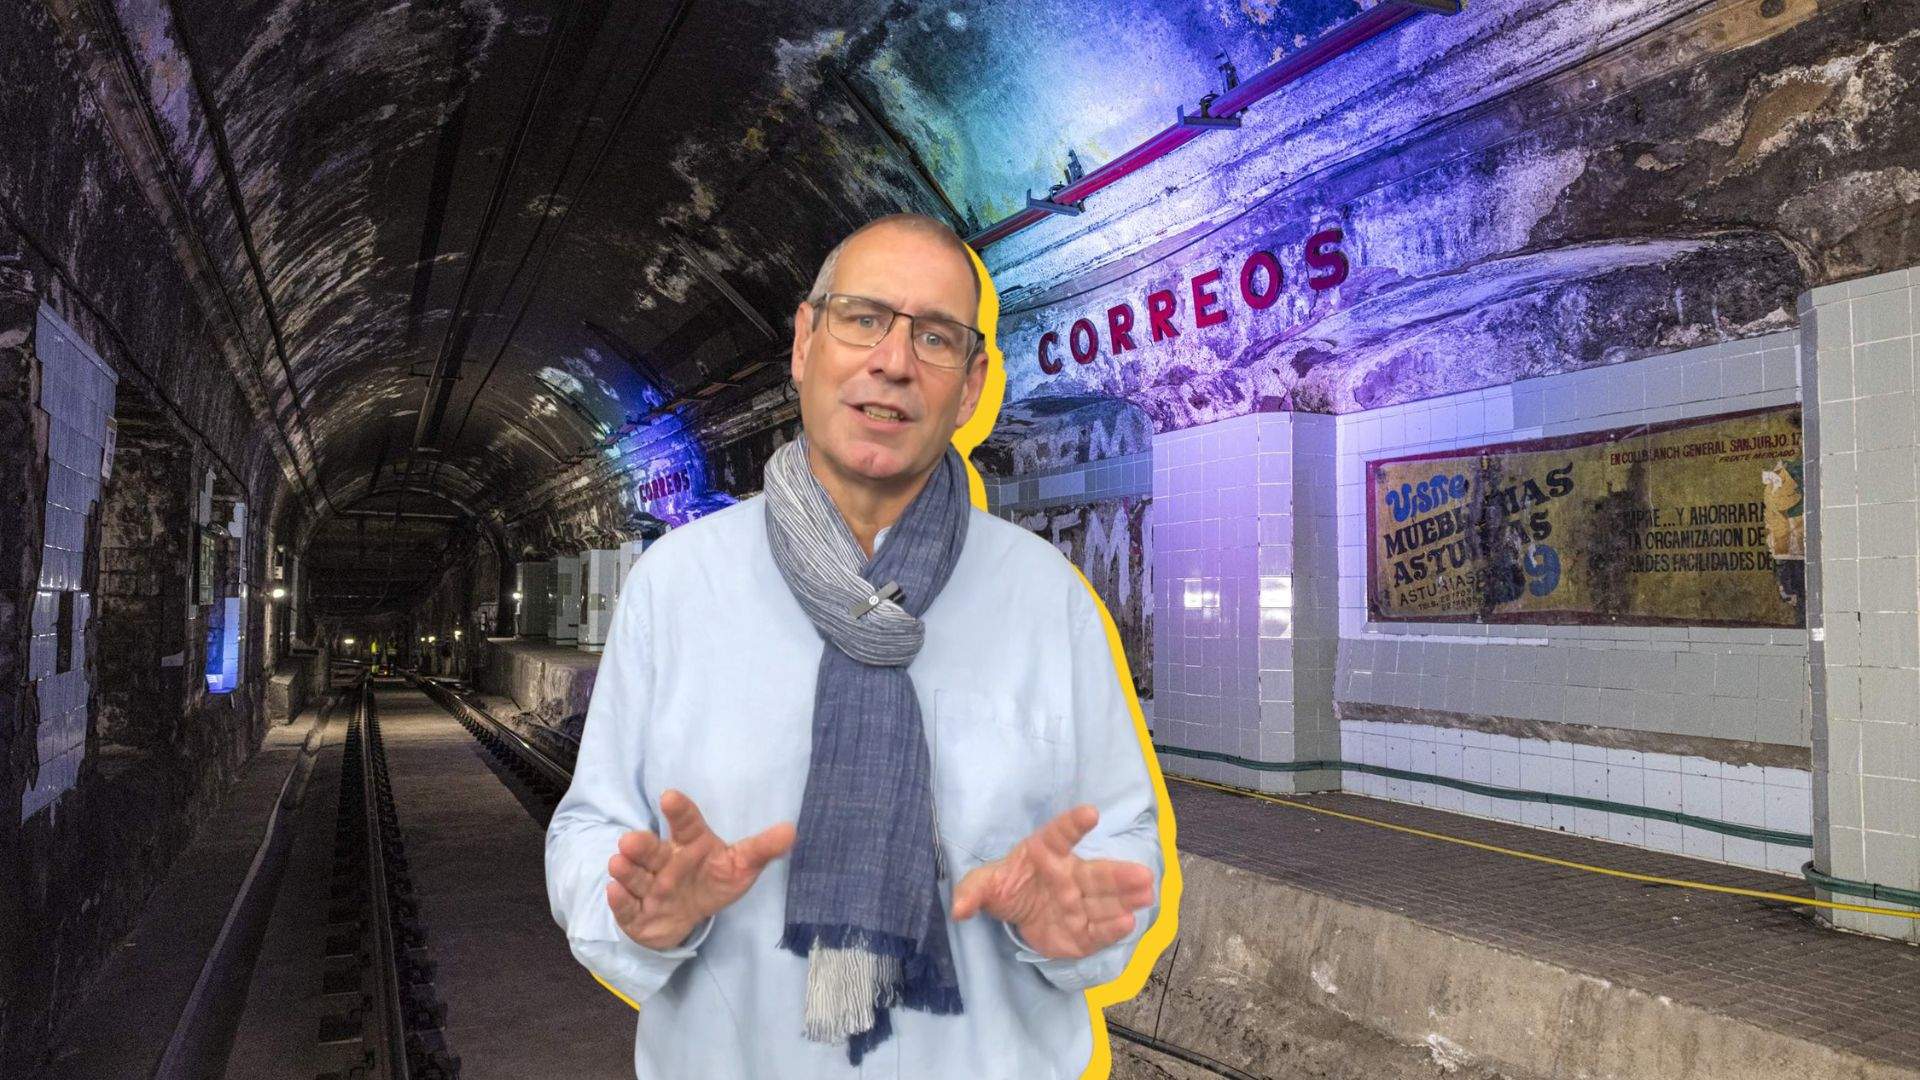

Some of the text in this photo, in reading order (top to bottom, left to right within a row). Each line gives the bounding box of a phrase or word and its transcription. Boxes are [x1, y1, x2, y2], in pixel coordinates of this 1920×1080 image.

[1037, 228, 1350, 375] CORREOS
[1683, 441, 1727, 457] GENERAL
[638, 468, 690, 503] CORREOS
[1645, 529, 1744, 551] ORGANIZACION
[1673, 552, 1755, 574] FACILIDADES
